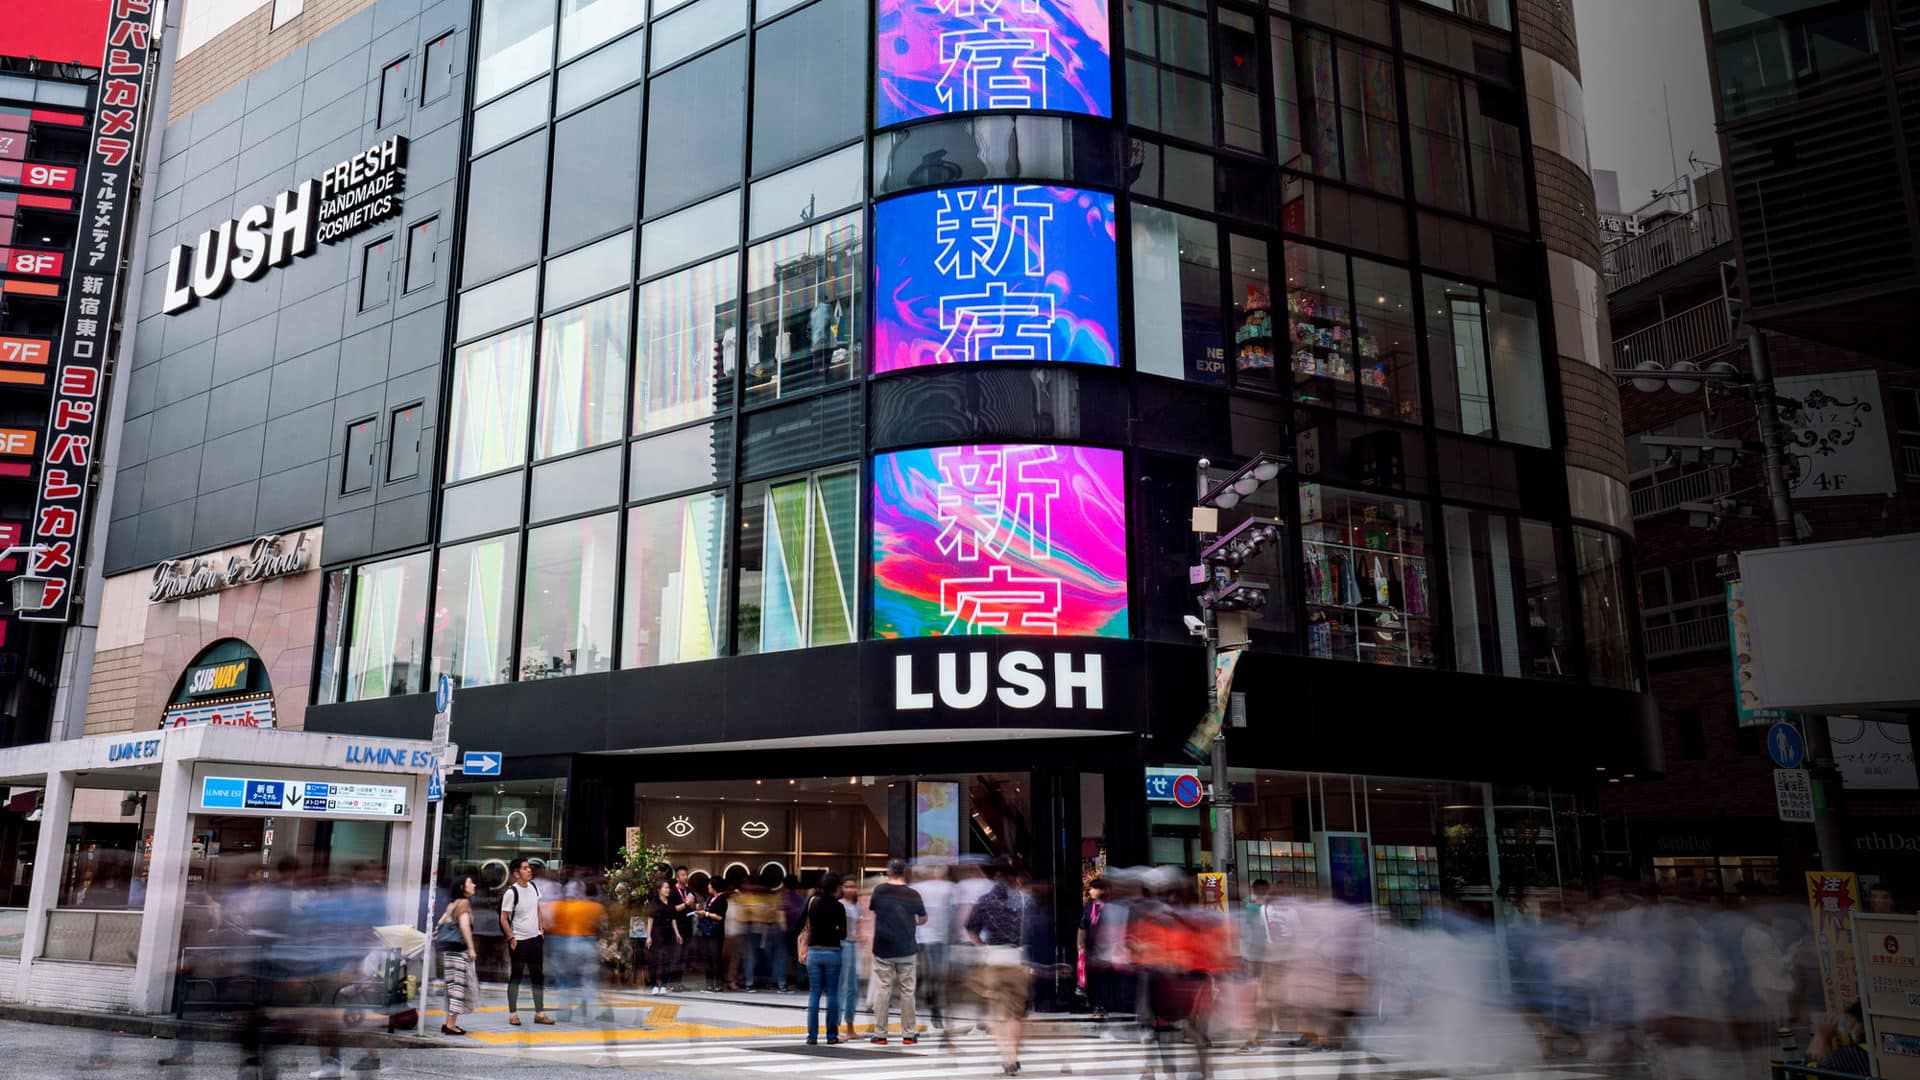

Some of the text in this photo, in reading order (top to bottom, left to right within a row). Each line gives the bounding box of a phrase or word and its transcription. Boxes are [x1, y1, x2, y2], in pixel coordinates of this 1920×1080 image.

[29, 167, 68, 186] 9F
[321, 134, 398, 199] FRESH
[89, 171, 118, 267] マルチメディア
[317, 195, 392, 243] COSMETICS
[318, 170, 395, 222] HANDMADE
[15, 253, 54, 273] 8F
[163, 178, 313, 314] LUSH
[934, 185, 1054, 363] 新宿
[73, 275, 104, 358] 新宿東口
[2, 341, 39, 361] 7F
[1812, 472, 1847, 490] 4F
[935, 445, 1061, 636] 新宿
[150, 532, 306, 602] Fashion & Foods
[189, 661, 246, 693] SUBWAY
[896, 650, 1103, 710] LUSH
[109, 739, 161, 762] LUMINE EST
[346, 746, 406, 765] LUMINE
